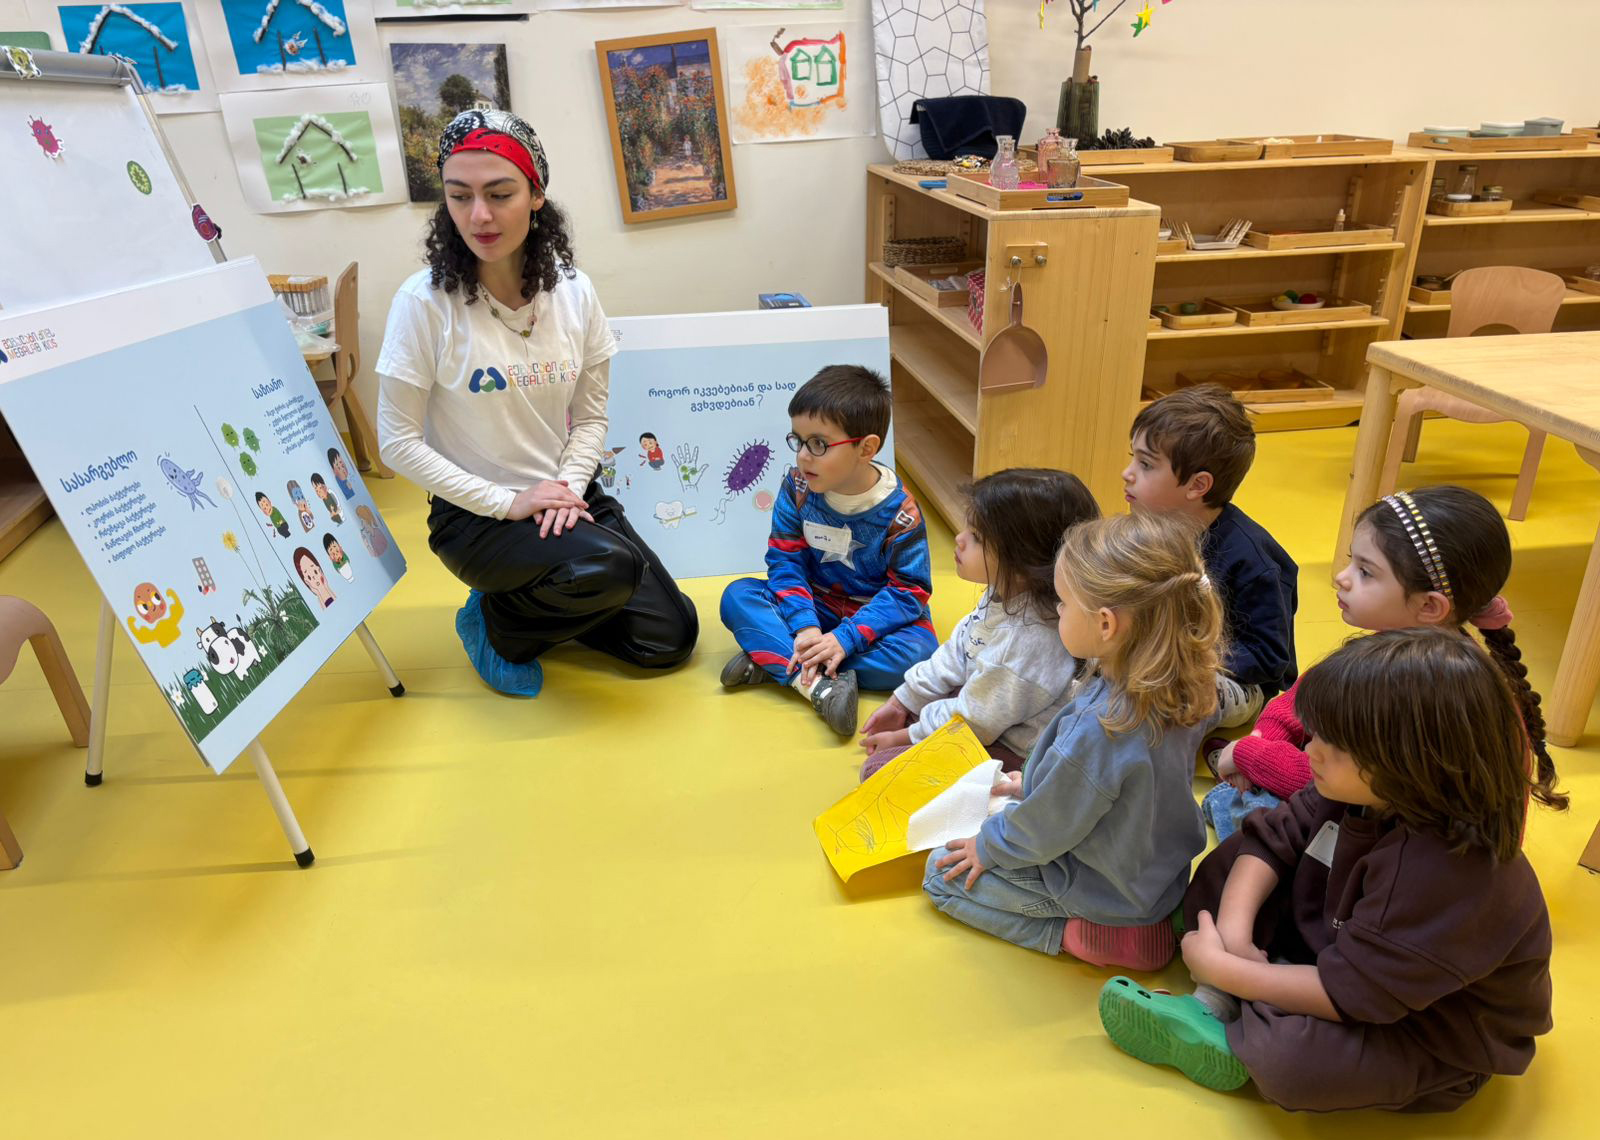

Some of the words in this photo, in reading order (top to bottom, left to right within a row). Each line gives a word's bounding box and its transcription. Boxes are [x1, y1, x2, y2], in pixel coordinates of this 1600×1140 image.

[251, 378, 284, 399] საზიანო
[508, 373, 556, 388] MEGALAB
[560, 370, 577, 383] KIDS
[648, 386, 690, 399] როგორ
[693, 382, 755, 397] იკვებებიან
[757, 383, 773, 393] და
[775, 381, 797, 392] სად
[59, 450, 138, 493] სასარგებლო
[109, 481, 141, 501] ბაქტერიები
[114, 493, 146, 514] ბაქტერიები
[125, 502, 157, 522] ბაქტერიები
[135, 526, 167, 547] ბაქტერიები
